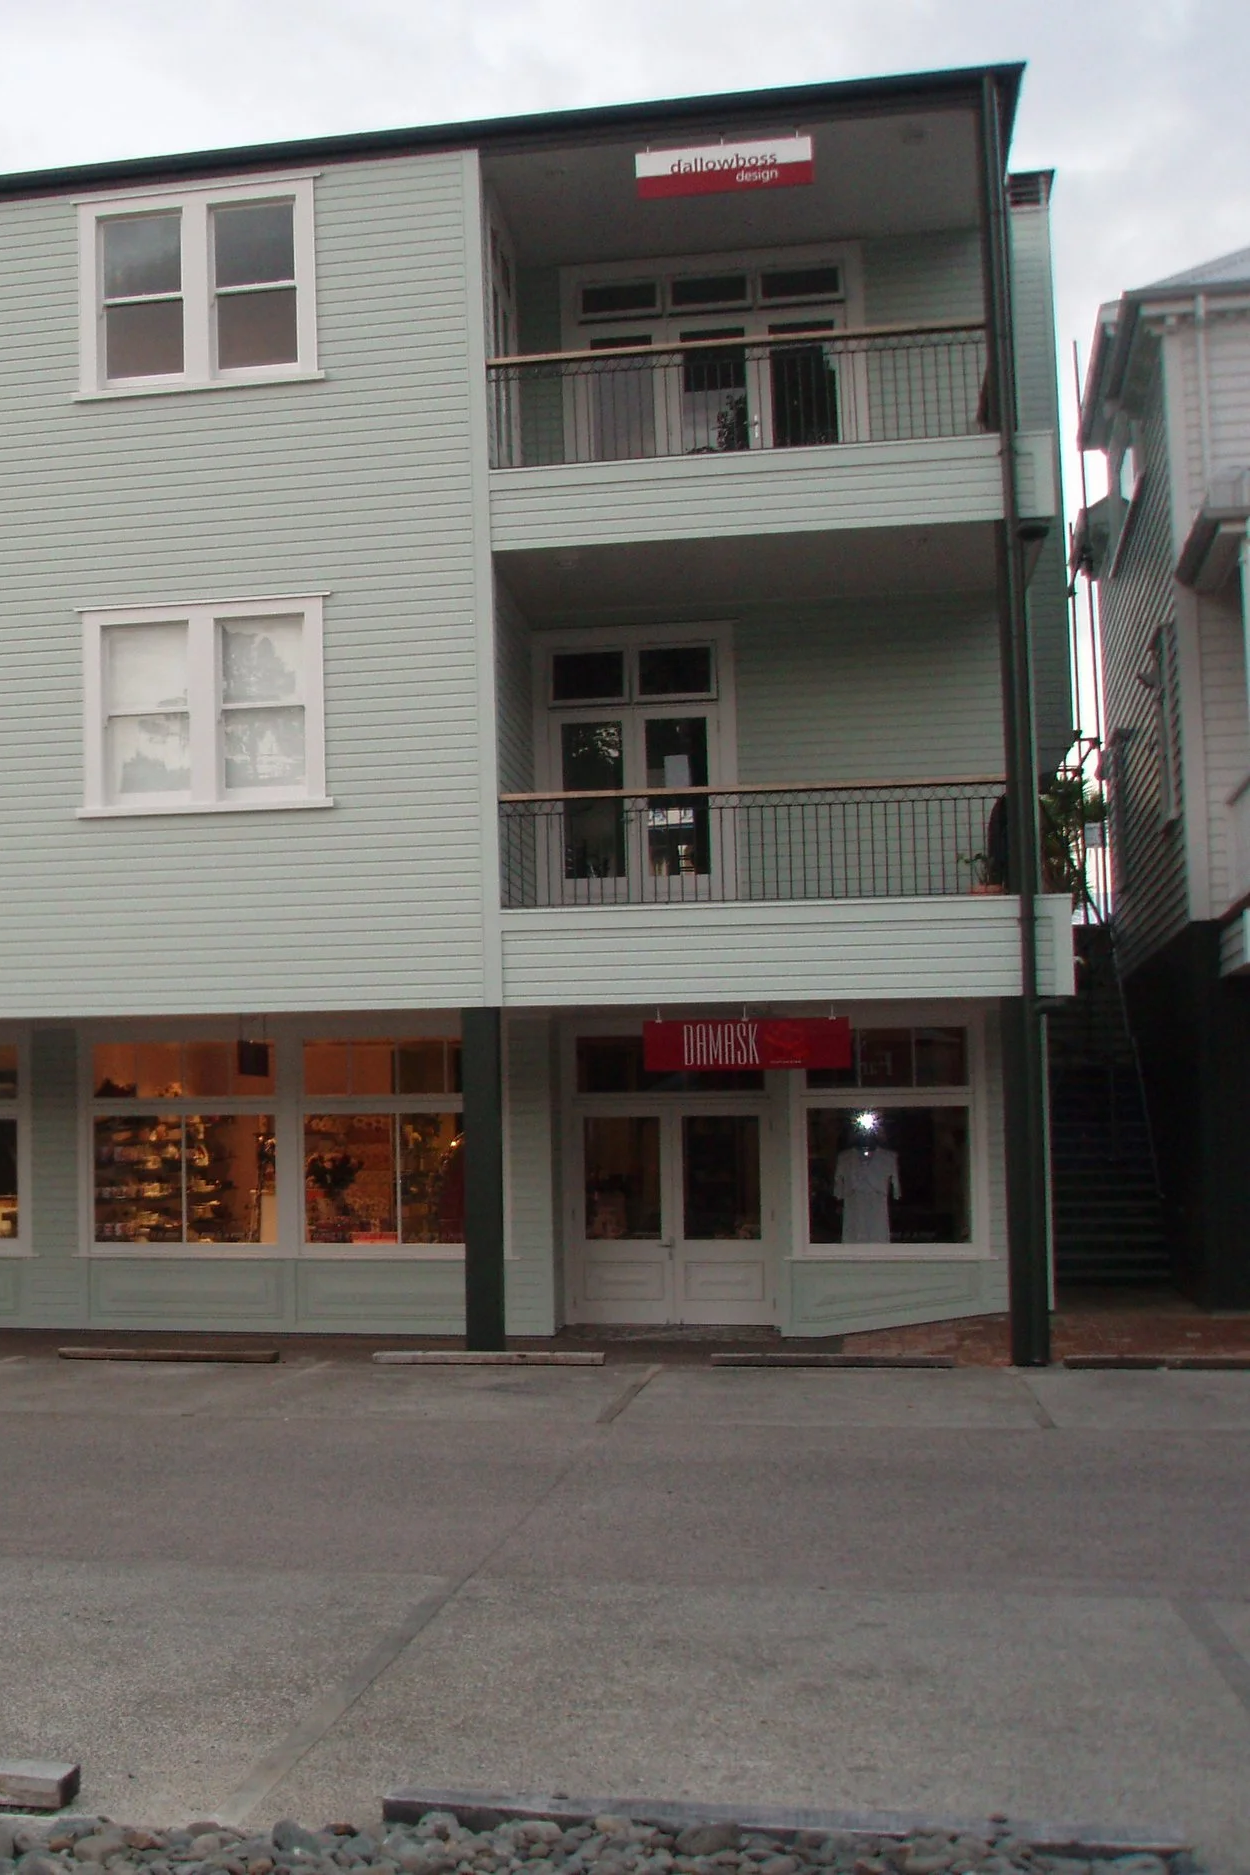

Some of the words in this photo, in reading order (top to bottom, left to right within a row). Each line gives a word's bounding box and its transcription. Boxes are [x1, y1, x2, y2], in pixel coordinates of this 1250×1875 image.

[670, 152, 777, 174] dallowboss
[735, 168, 779, 183] design
[683, 1023, 760, 1066] DAMASK
